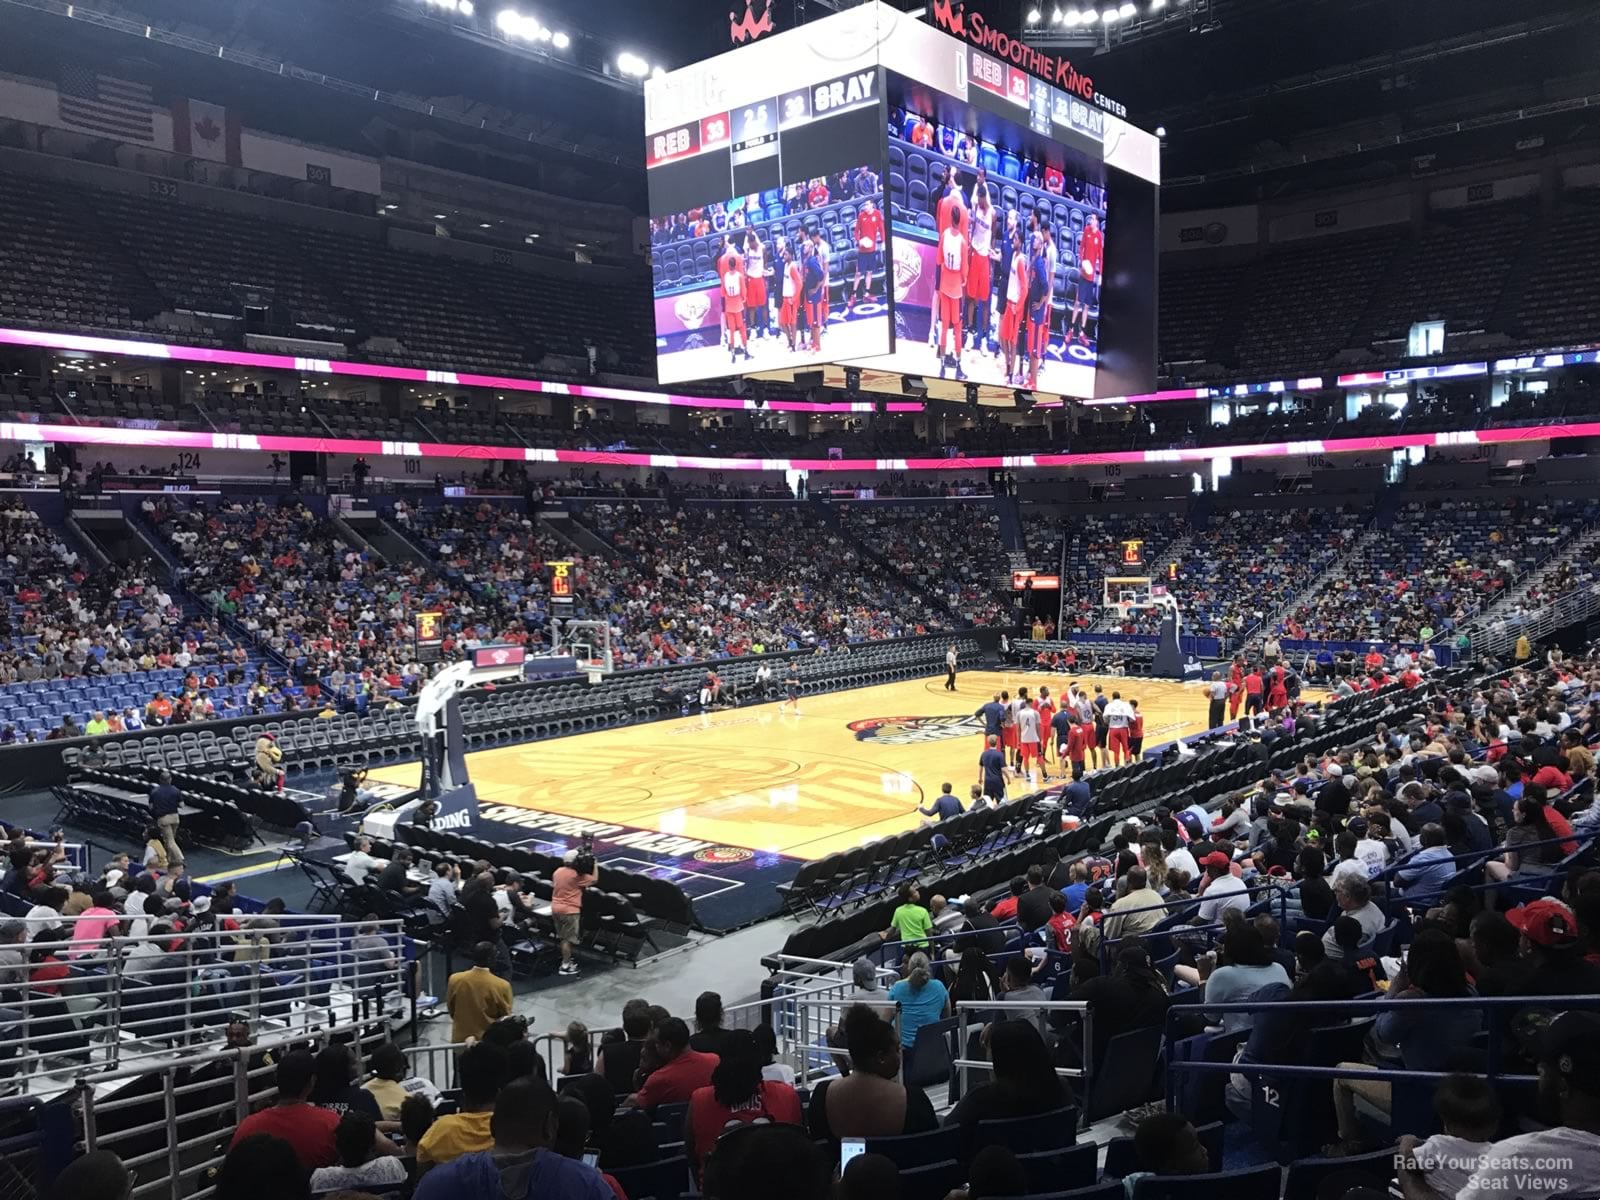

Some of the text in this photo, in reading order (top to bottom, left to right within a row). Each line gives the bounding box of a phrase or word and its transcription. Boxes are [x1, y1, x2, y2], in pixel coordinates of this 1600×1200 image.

[970, 12, 1053, 79] SMOOTHIE
[1094, 91, 1126, 117] CENTER
[151, 181, 177, 197] 332
[178, 453, 201, 471] 124
[404, 459, 421, 474] 101
[1307, 455, 1325, 467] 106
[708, 472, 724, 484] 103
[1104, 465, 1121, 477] 105
[1054, 962, 1061, 971] 6
[1262, 1086, 1280, 1108] 12
